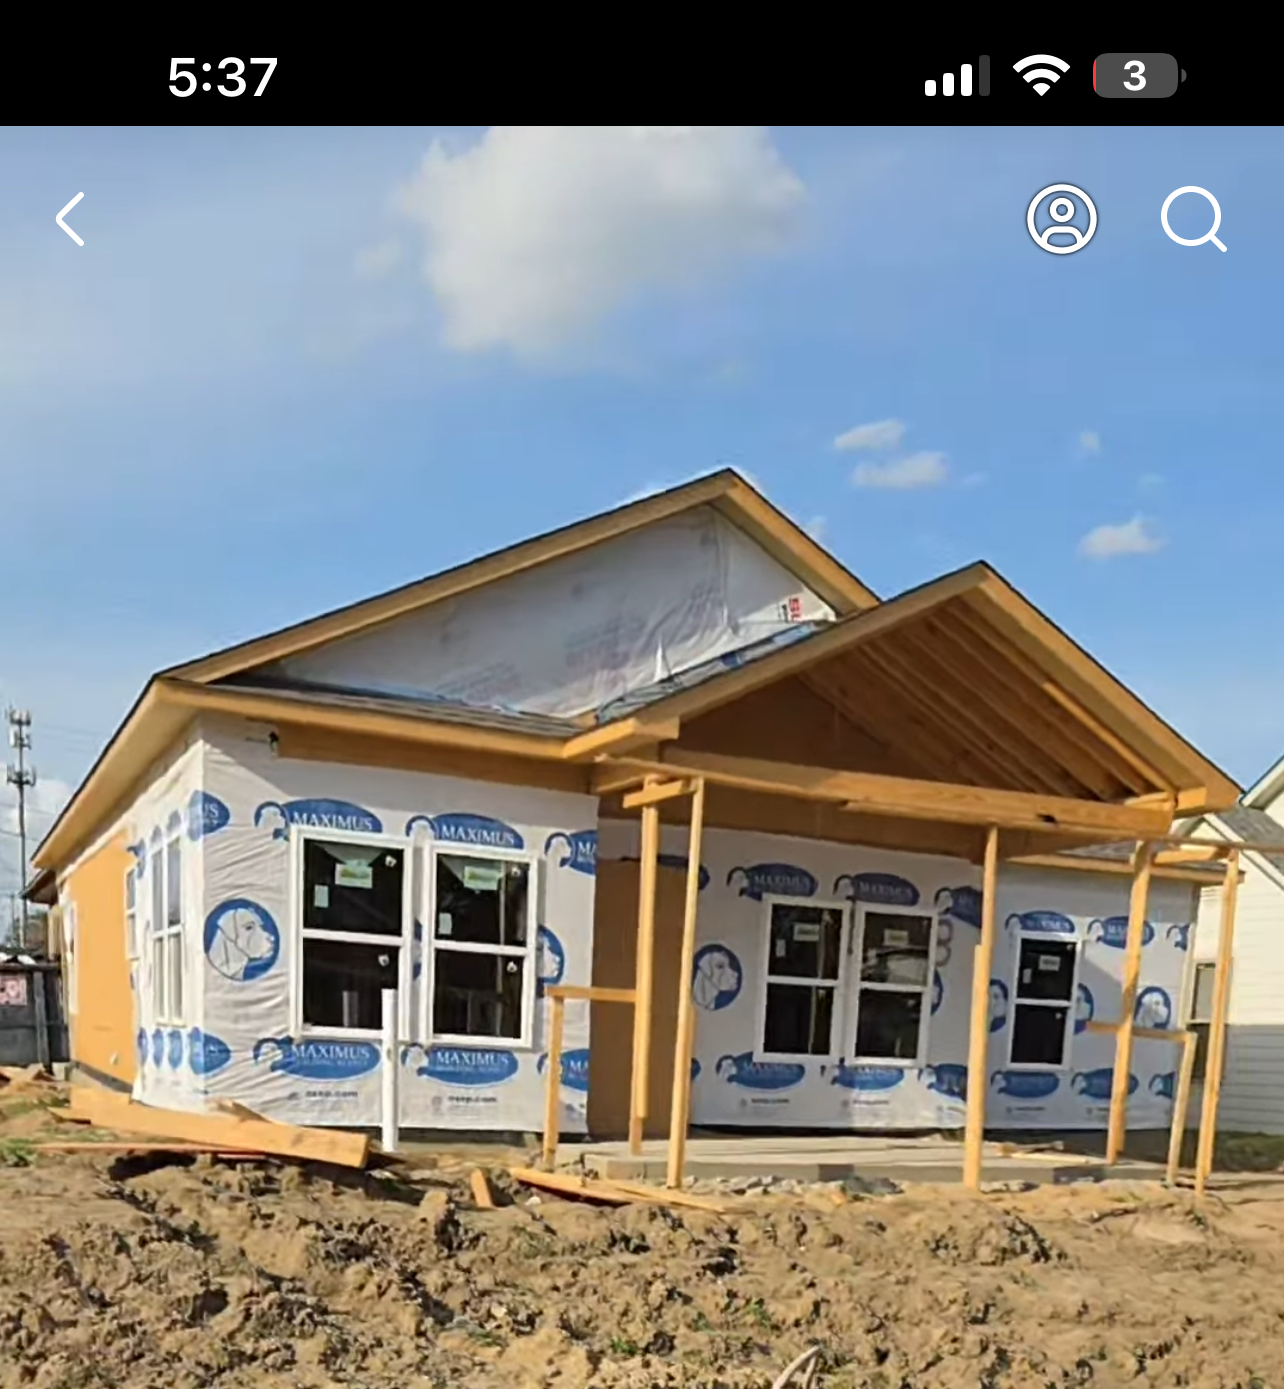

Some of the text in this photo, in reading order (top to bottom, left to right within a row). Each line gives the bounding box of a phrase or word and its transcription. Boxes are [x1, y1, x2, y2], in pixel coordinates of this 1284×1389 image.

[292, 811, 373, 831] MAXIMUS
[440, 824, 515, 846] MAXIMUS
[291, 1044, 371, 1060] MAXIMUS
[437, 1051, 510, 1066] MAXIMUS
